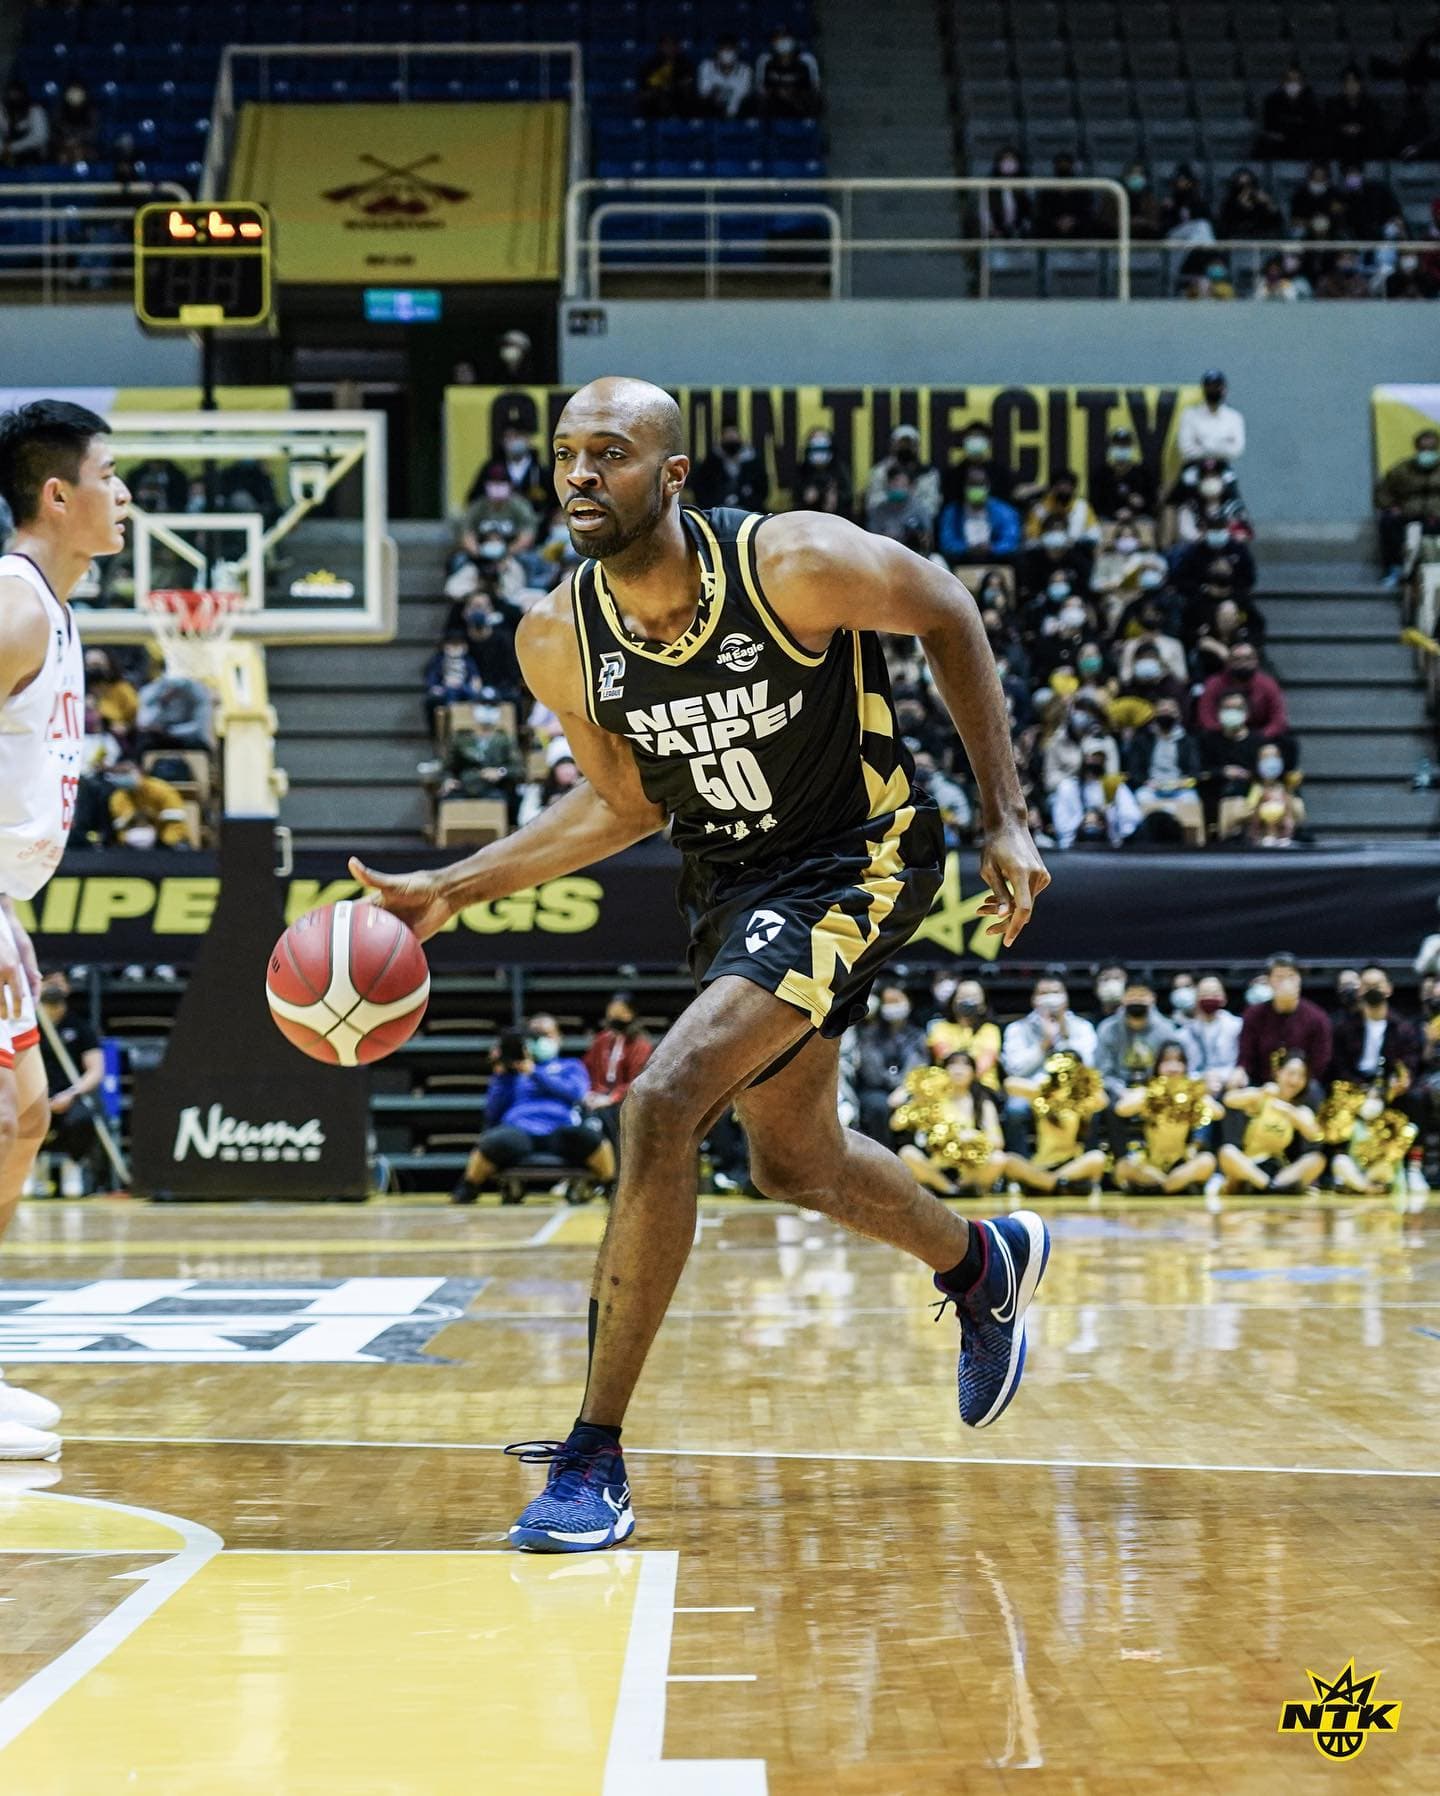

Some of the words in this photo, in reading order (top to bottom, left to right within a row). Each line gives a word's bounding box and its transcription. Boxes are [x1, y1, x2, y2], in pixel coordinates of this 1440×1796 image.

[991, 387, 1181, 491] CITY
[625, 679, 769, 733] NEW
[689, 747, 773, 812] 50
[284, 876, 604, 934] KGS
